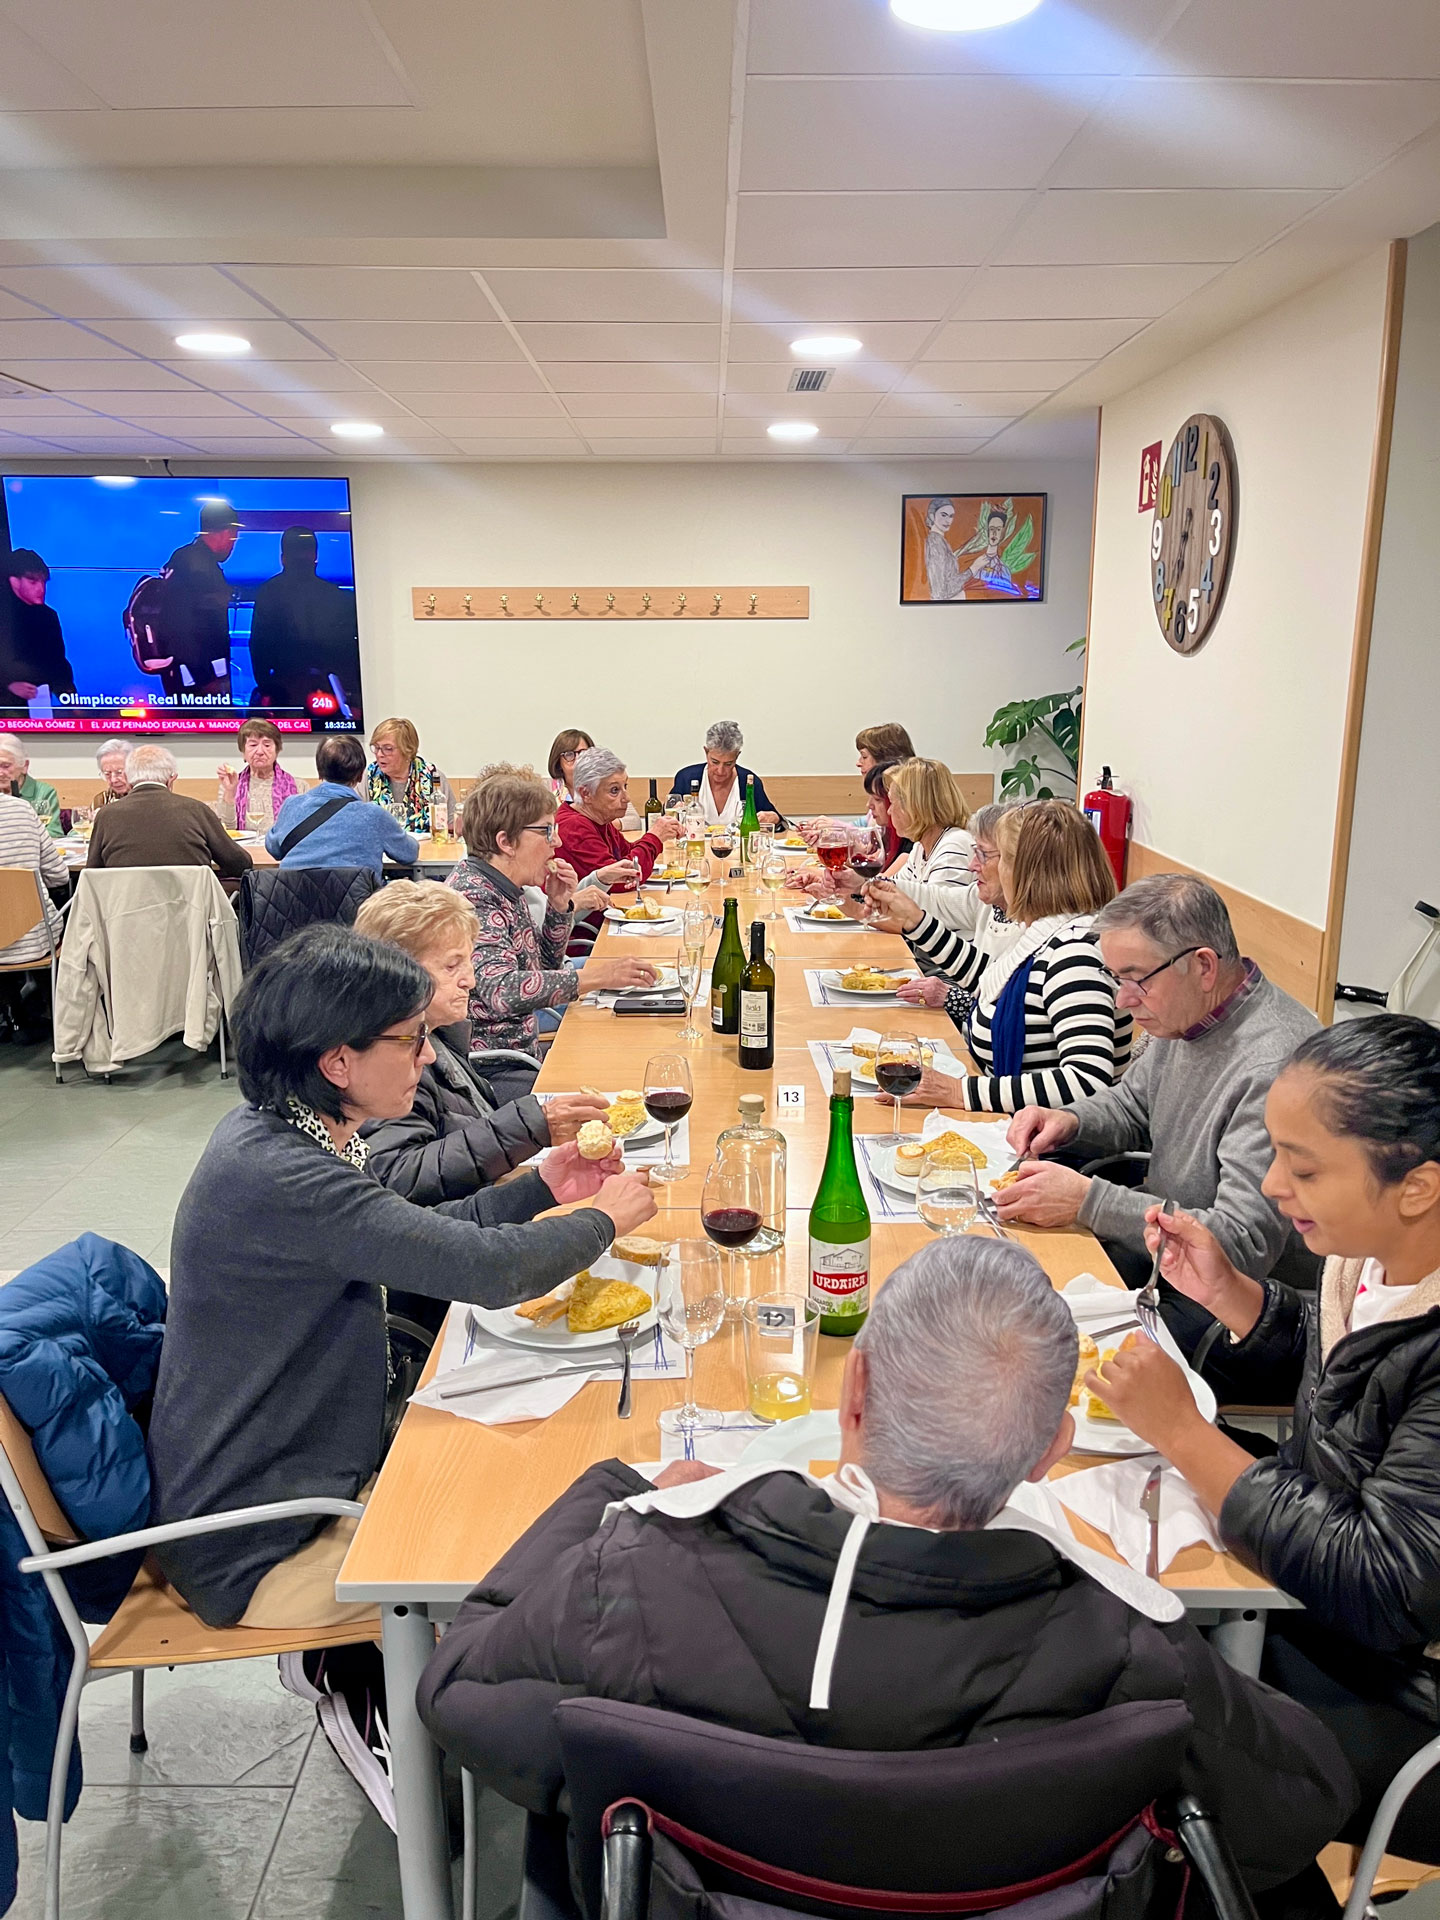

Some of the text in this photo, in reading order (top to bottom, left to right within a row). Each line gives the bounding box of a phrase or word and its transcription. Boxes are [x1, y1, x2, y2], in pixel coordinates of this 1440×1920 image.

[1172, 441, 1184, 487] 11
[1184, 424, 1199, 473] 12
[1202, 431, 1209, 480] 1
[1159, 474, 1172, 519] 10
[1207, 461, 1220, 511] 2
[1151, 519, 1163, 561] 9
[1209, 508, 1222, 556] 3
[1155, 561, 1165, 603] 8
[1201, 557, 1214, 604] 4
[1163, 588, 1175, 631] 7
[1174, 600, 1187, 644] 6
[1187, 588, 1201, 634] 5
[59, 692, 135, 708] Olimpiacos
[147, 693, 178, 705] Real
[181, 693, 231, 705] Madrid
[312, 697, 333, 708] 24h
[7, 719, 44, 729] BEGOÑA
[45, 719, 76, 729] GÓMEZ
[91, 721, 100, 729] EL
[102, 721, 121, 729] JUEZ
[123, 721, 161, 729] PEINADO
[162, 721, 195, 729] EXPULSA
[198, 721, 205, 729] A
[277, 721, 293, 729] DEL
[324, 721, 357, 729] 18:32:31
[783, 1091, 800, 1103] 13
[763, 1311, 786, 1327] 12
